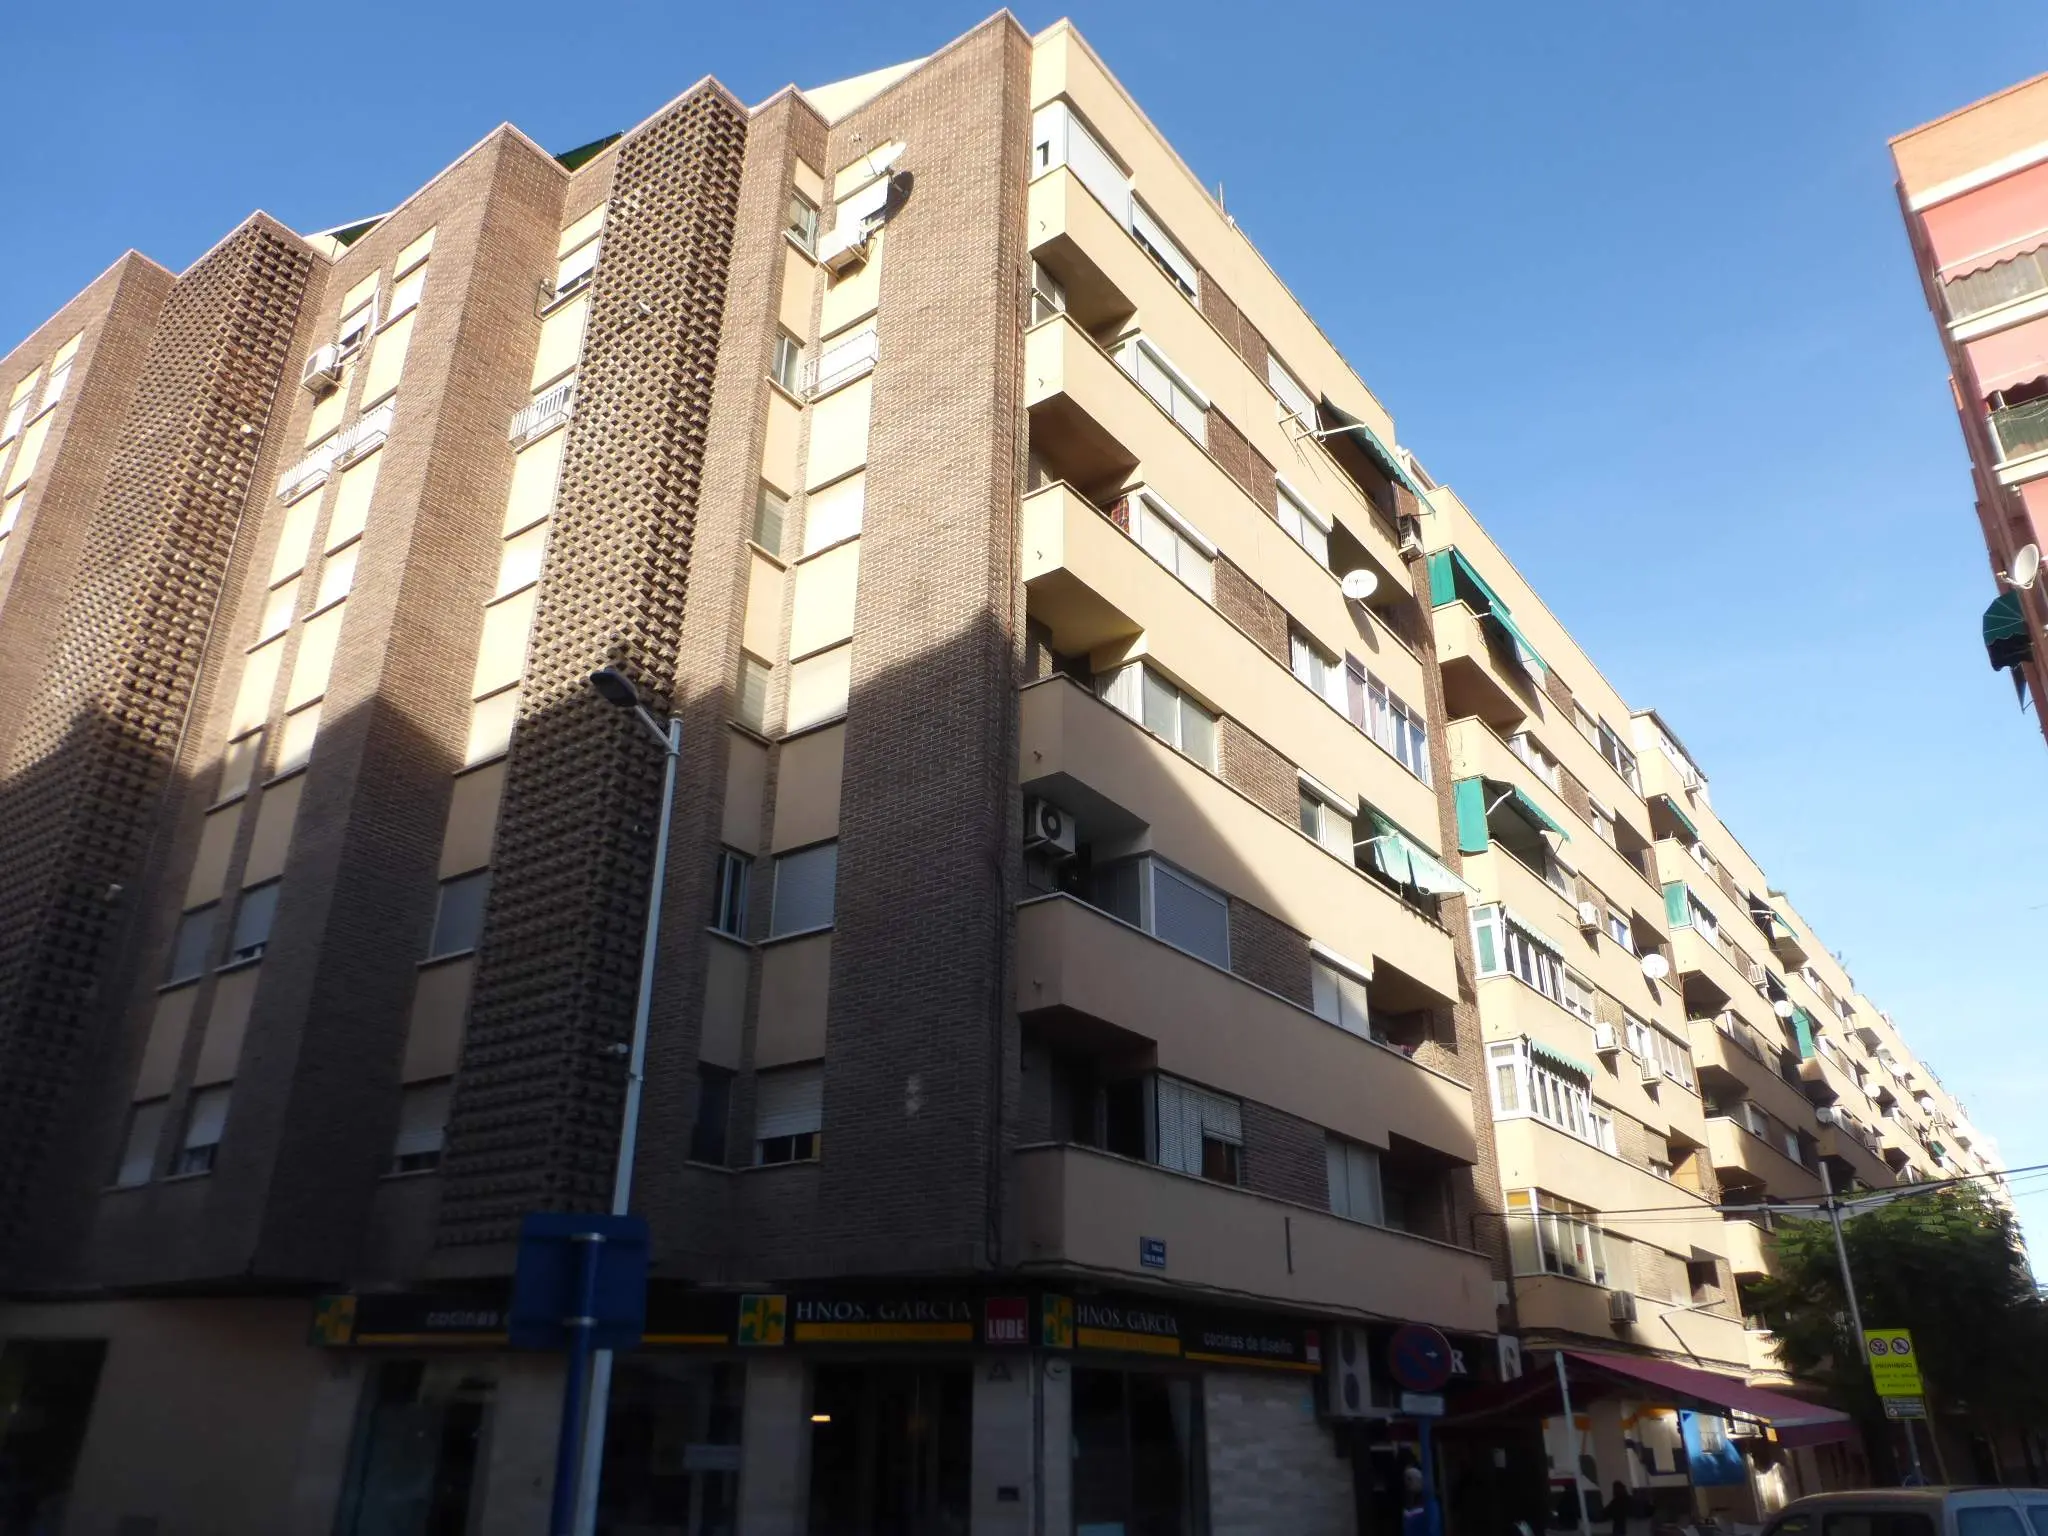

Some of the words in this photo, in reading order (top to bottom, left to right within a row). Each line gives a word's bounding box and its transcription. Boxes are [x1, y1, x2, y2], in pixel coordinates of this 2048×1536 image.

[796, 1301, 871, 1321] HNOS.
[1076, 1303, 1124, 1328] HNOS.
[1203, 1331, 1245, 1350] cocinas
[1245, 1333, 1259, 1352] de
